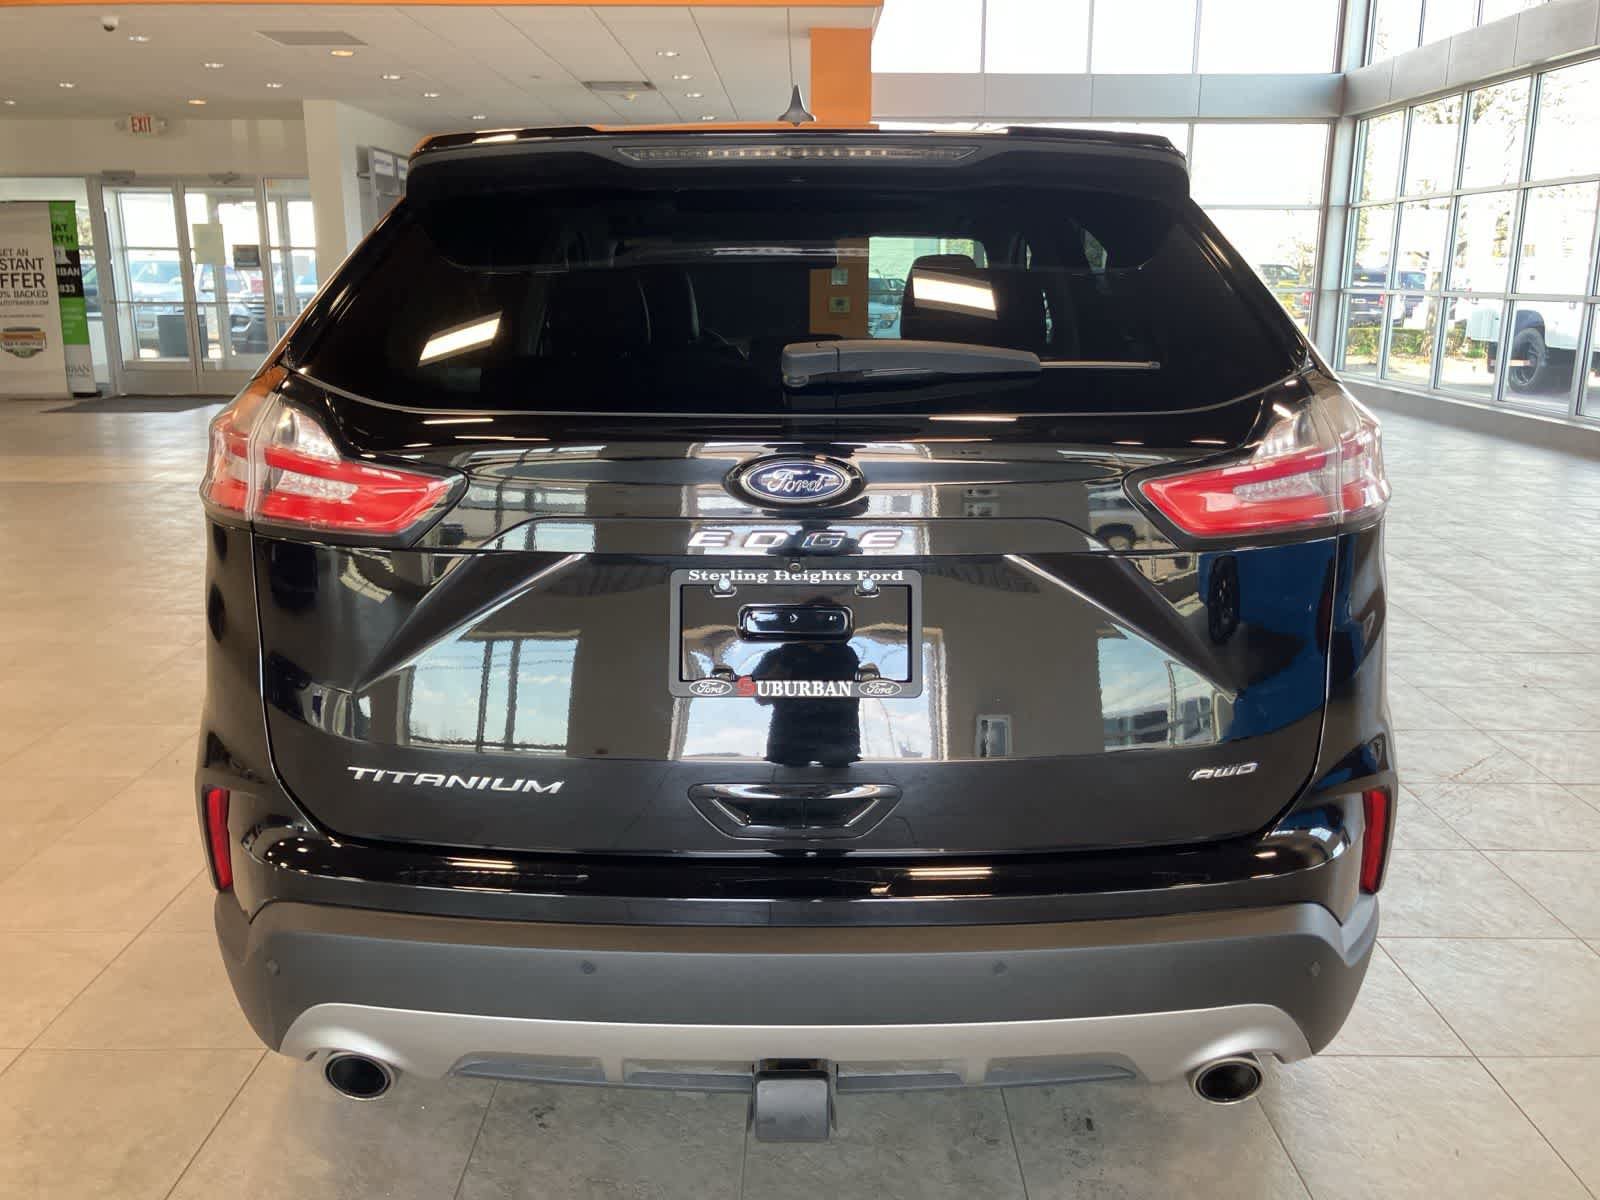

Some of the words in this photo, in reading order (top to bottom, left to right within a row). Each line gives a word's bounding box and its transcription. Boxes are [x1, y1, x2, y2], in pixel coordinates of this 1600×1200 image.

[131, 116, 152, 134] EXIT
[17, 248, 29, 257] AN
[14, 289, 49, 298] BACKED
[763, 468, 834, 493] Ford
[688, 530, 903, 549] EDGE
[689, 569, 768, 583] Sterling
[774, 569, 850, 583] Heights
[857, 570, 904, 581] Ford
[695, 680, 727, 695] Ford
[736, 676, 852, 697] SUBURBAN
[865, 680, 894, 695] Ford
[347, 766, 565, 794] TITANIUM
[1190, 762, 1258, 781] AWD
